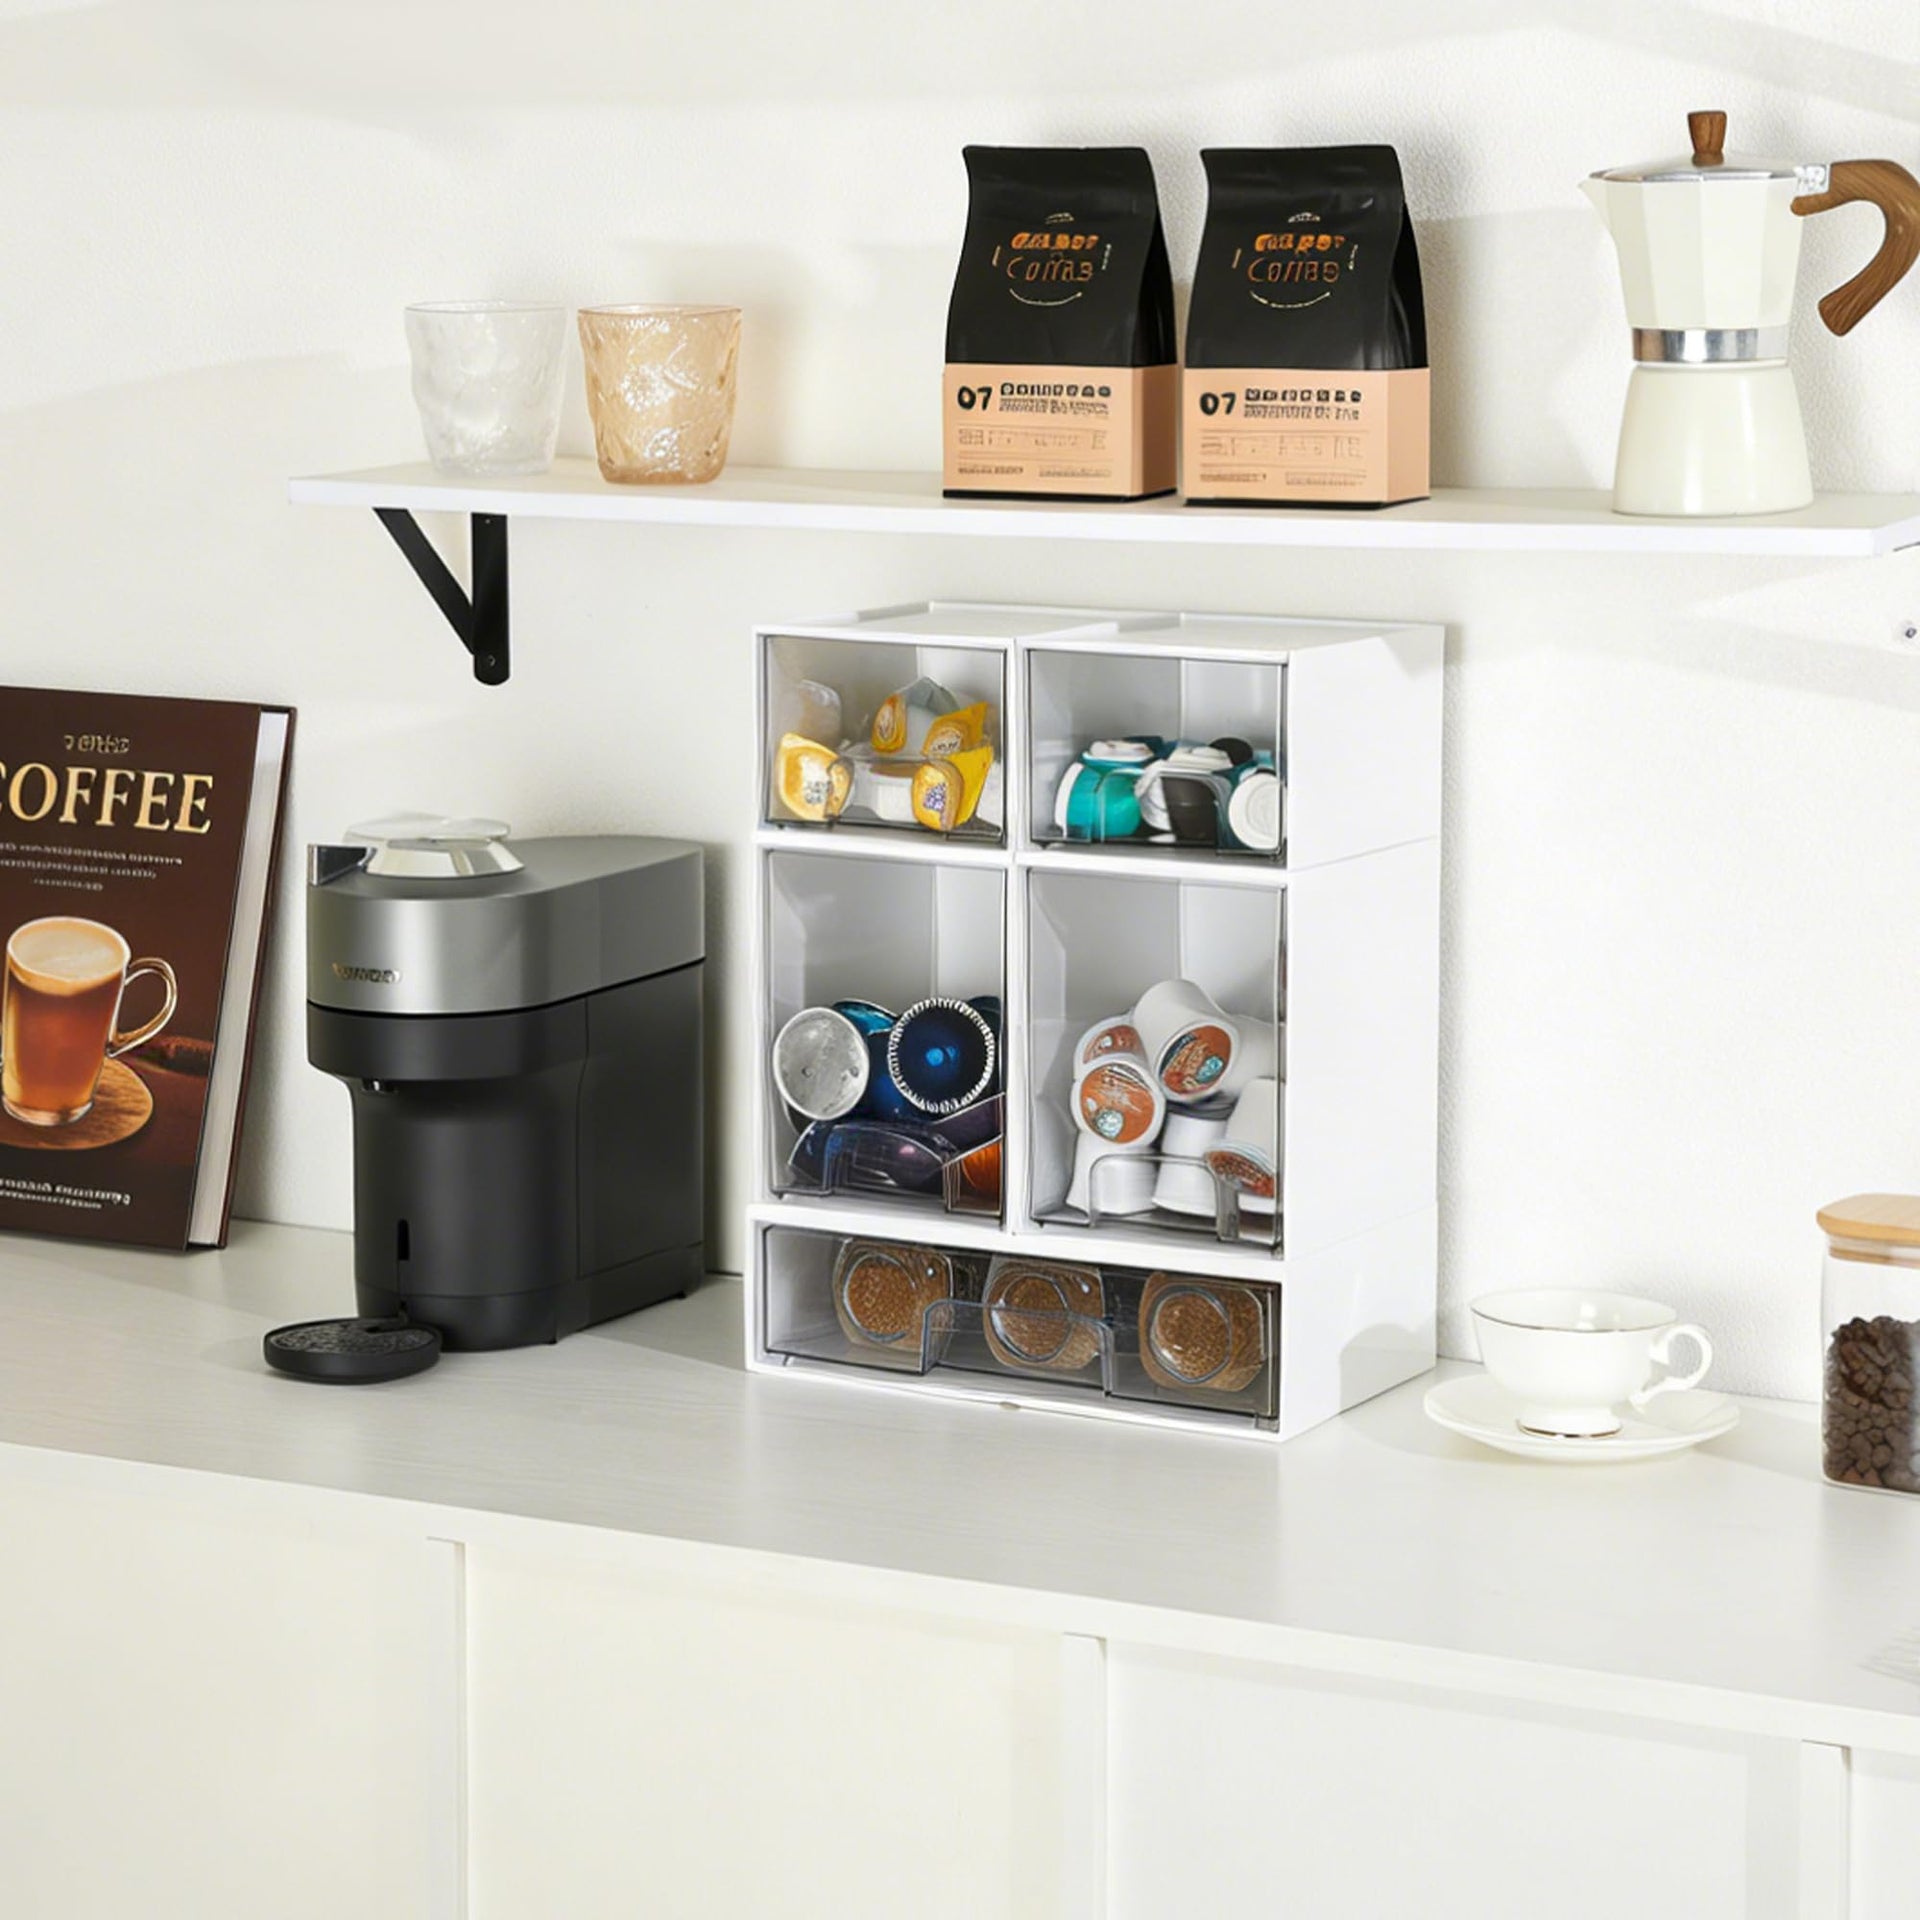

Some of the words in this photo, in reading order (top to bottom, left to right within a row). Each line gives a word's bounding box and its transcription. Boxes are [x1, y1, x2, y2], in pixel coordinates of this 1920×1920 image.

[957, 385, 993, 411] 07
[1199, 392, 1236, 416] 07
[0, 761, 213, 834] OFFEE
